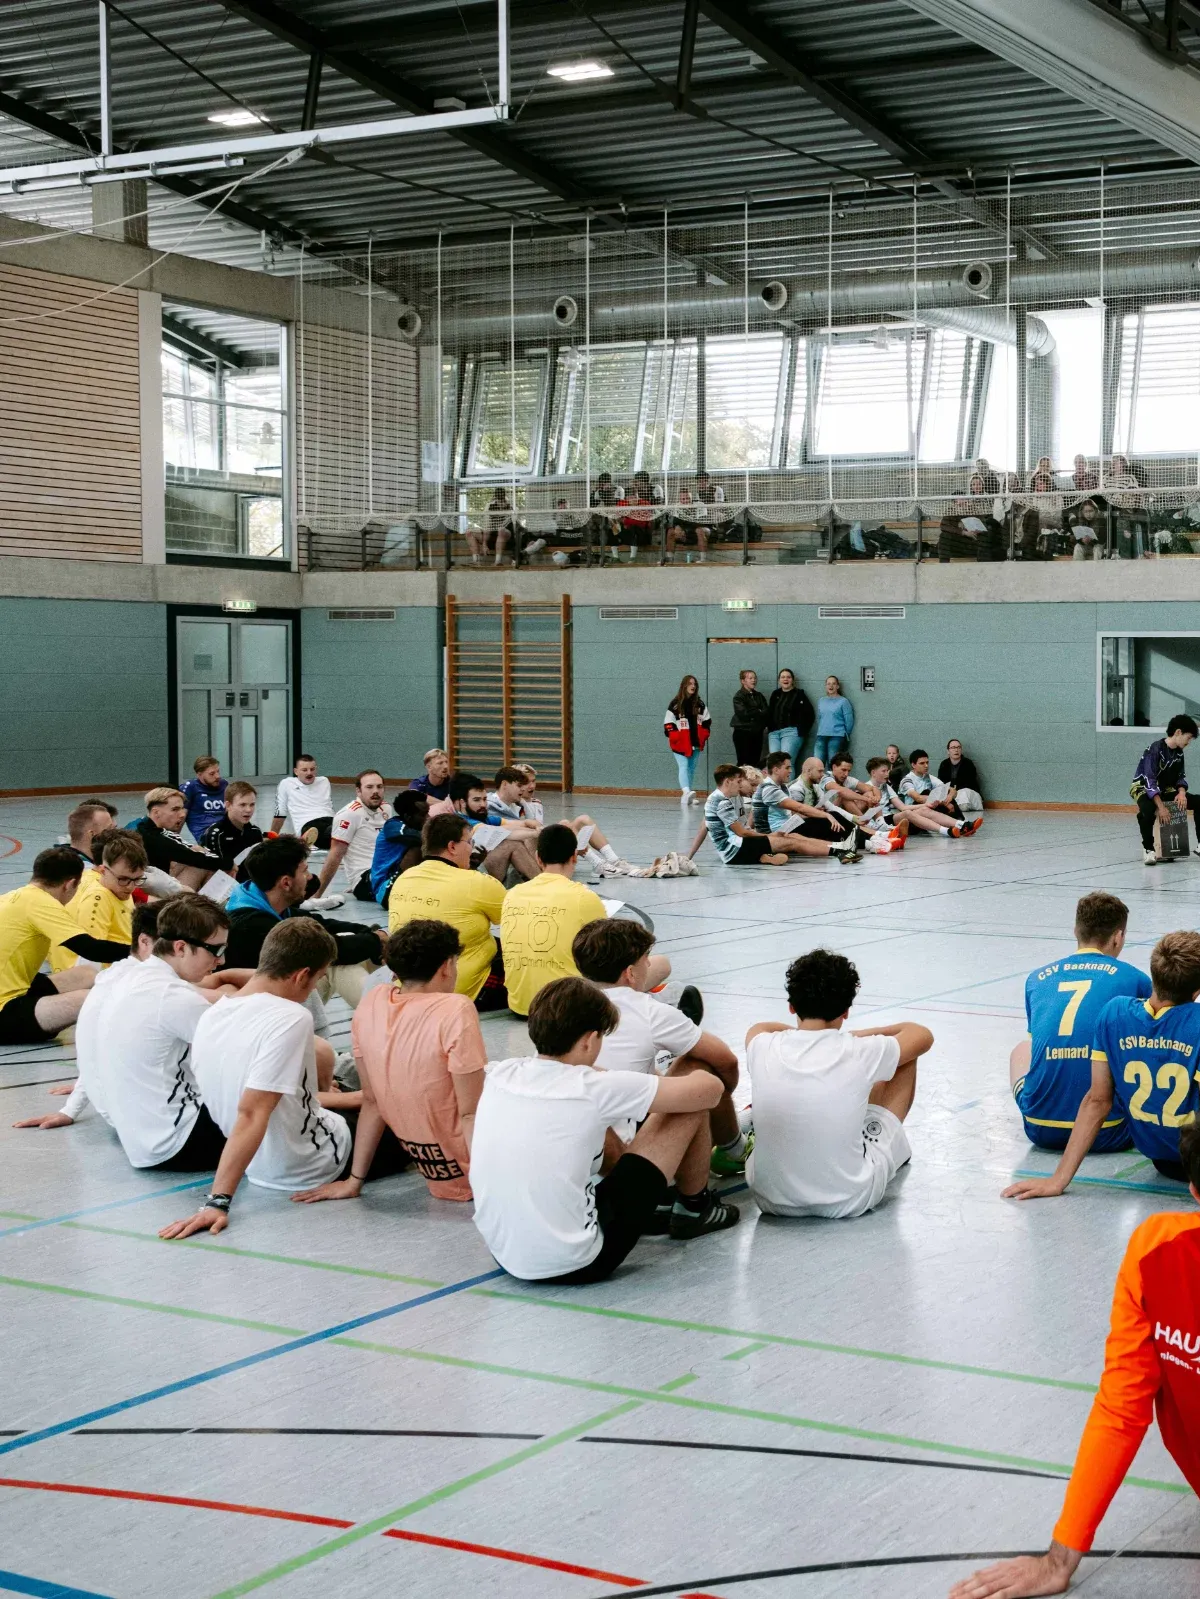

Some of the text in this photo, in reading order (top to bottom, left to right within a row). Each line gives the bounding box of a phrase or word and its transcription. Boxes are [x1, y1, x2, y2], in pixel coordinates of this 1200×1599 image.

[503, 914, 559, 953] 20
[1038, 962, 1118, 981] CSV Backnang
[1058, 979, 1093, 1036] 7
[1045, 1045, 1090, 1061] Lennard
[1119, 1036, 1194, 1057] CSV Backnang
[1123, 1060, 1196, 1128] 22
[1160, 1352, 1193, 1370] nlagen-
